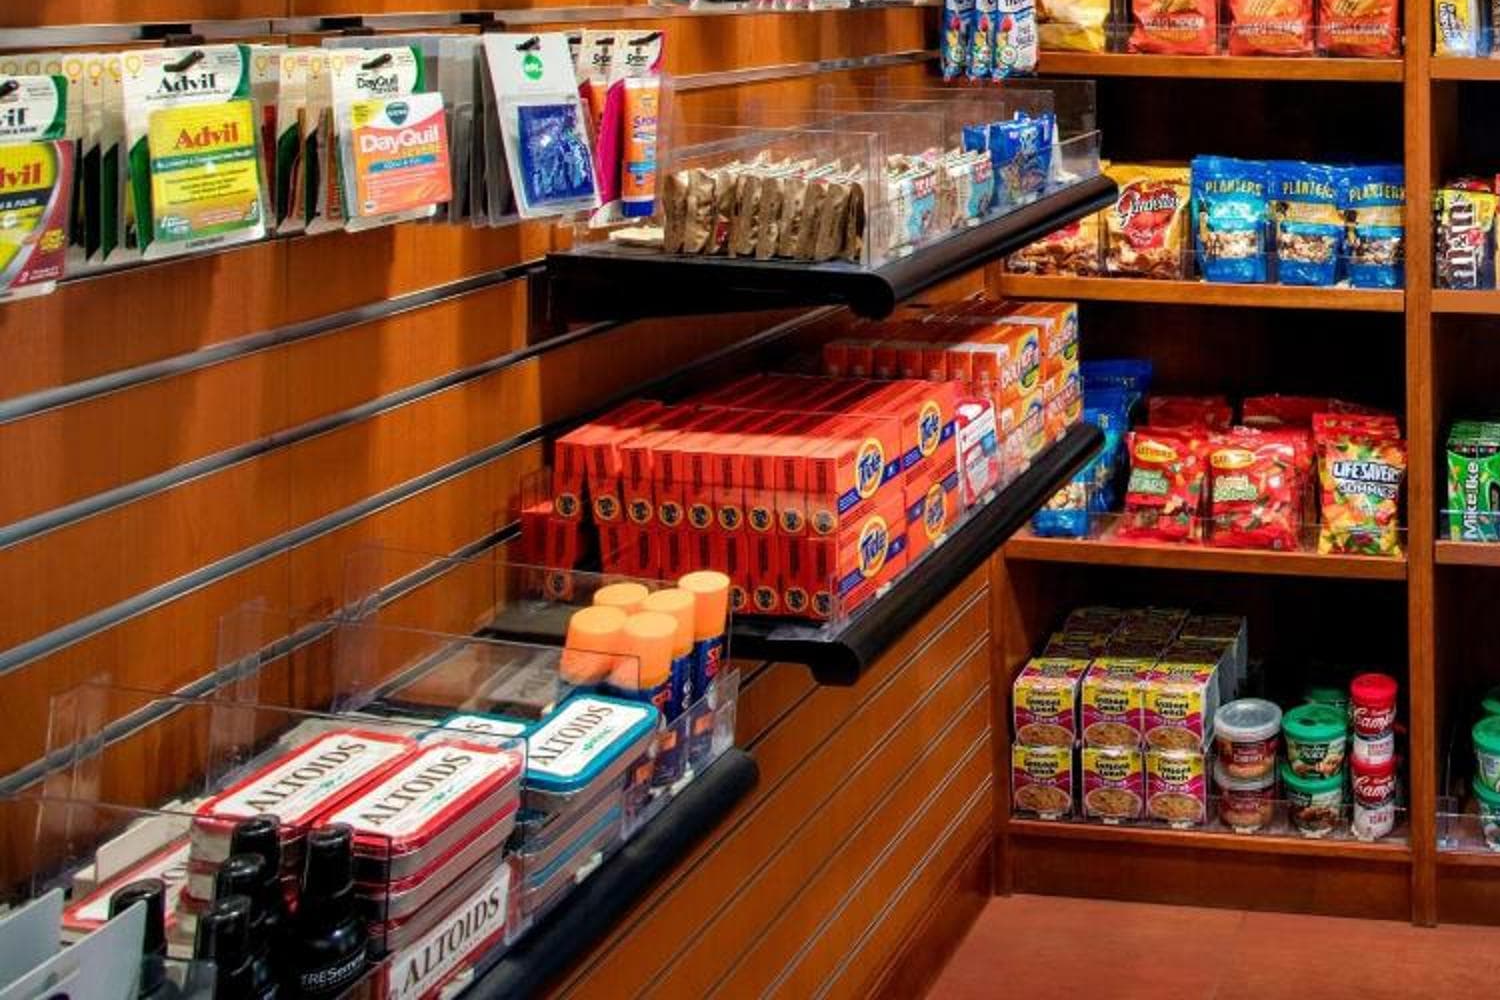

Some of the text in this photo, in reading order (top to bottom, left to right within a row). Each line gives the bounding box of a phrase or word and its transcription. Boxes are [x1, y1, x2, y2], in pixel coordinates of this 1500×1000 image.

[156, 73, 217, 94] Advil
[356, 74, 399, 92] DayQuil
[174, 122, 240, 149] Advil
[360, 125, 439, 155] DayQuil
[1205, 180, 1263, 197] PLANTERS
[859, 455, 882, 487] Tide
[1463, 461, 1480, 539] Mike Ike
[861, 530, 887, 567] Tide
[527, 702, 616, 768] ALTOIDS
[244, 738, 368, 813] ALTOIDS
[357, 750, 472, 827] ALTOIDS
[400, 885, 502, 988] ALTOIDS
